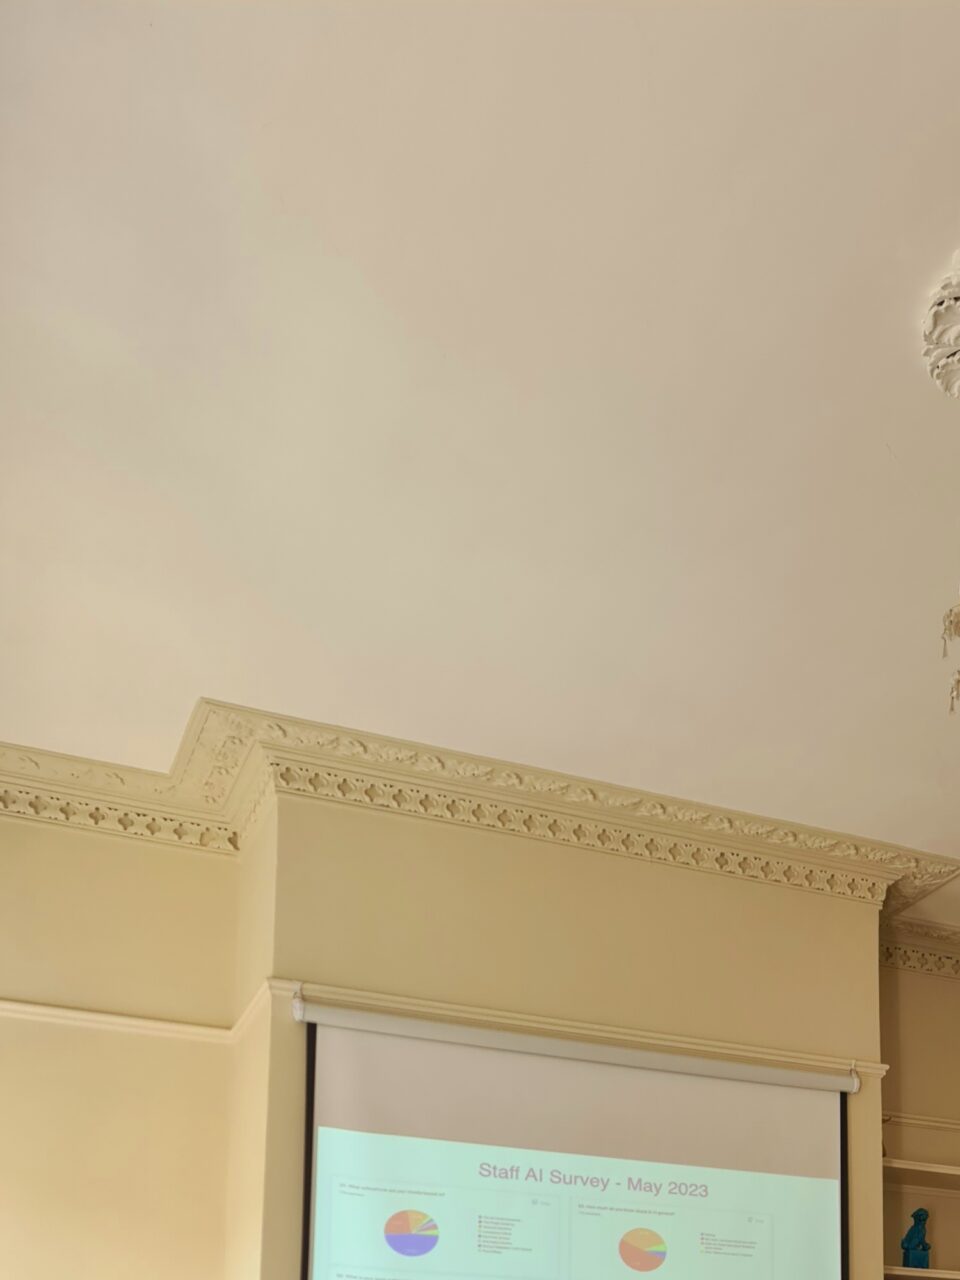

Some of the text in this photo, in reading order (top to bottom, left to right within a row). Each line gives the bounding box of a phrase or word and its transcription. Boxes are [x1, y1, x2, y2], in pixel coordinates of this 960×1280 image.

[478, 1162, 520, 1180] Staff
[524, 1168, 543, 1182] AI
[549, 1169, 610, 1192] Survey
[627, 1177, 663, 1197] May
[668, 1181, 709, 1198] 2023
